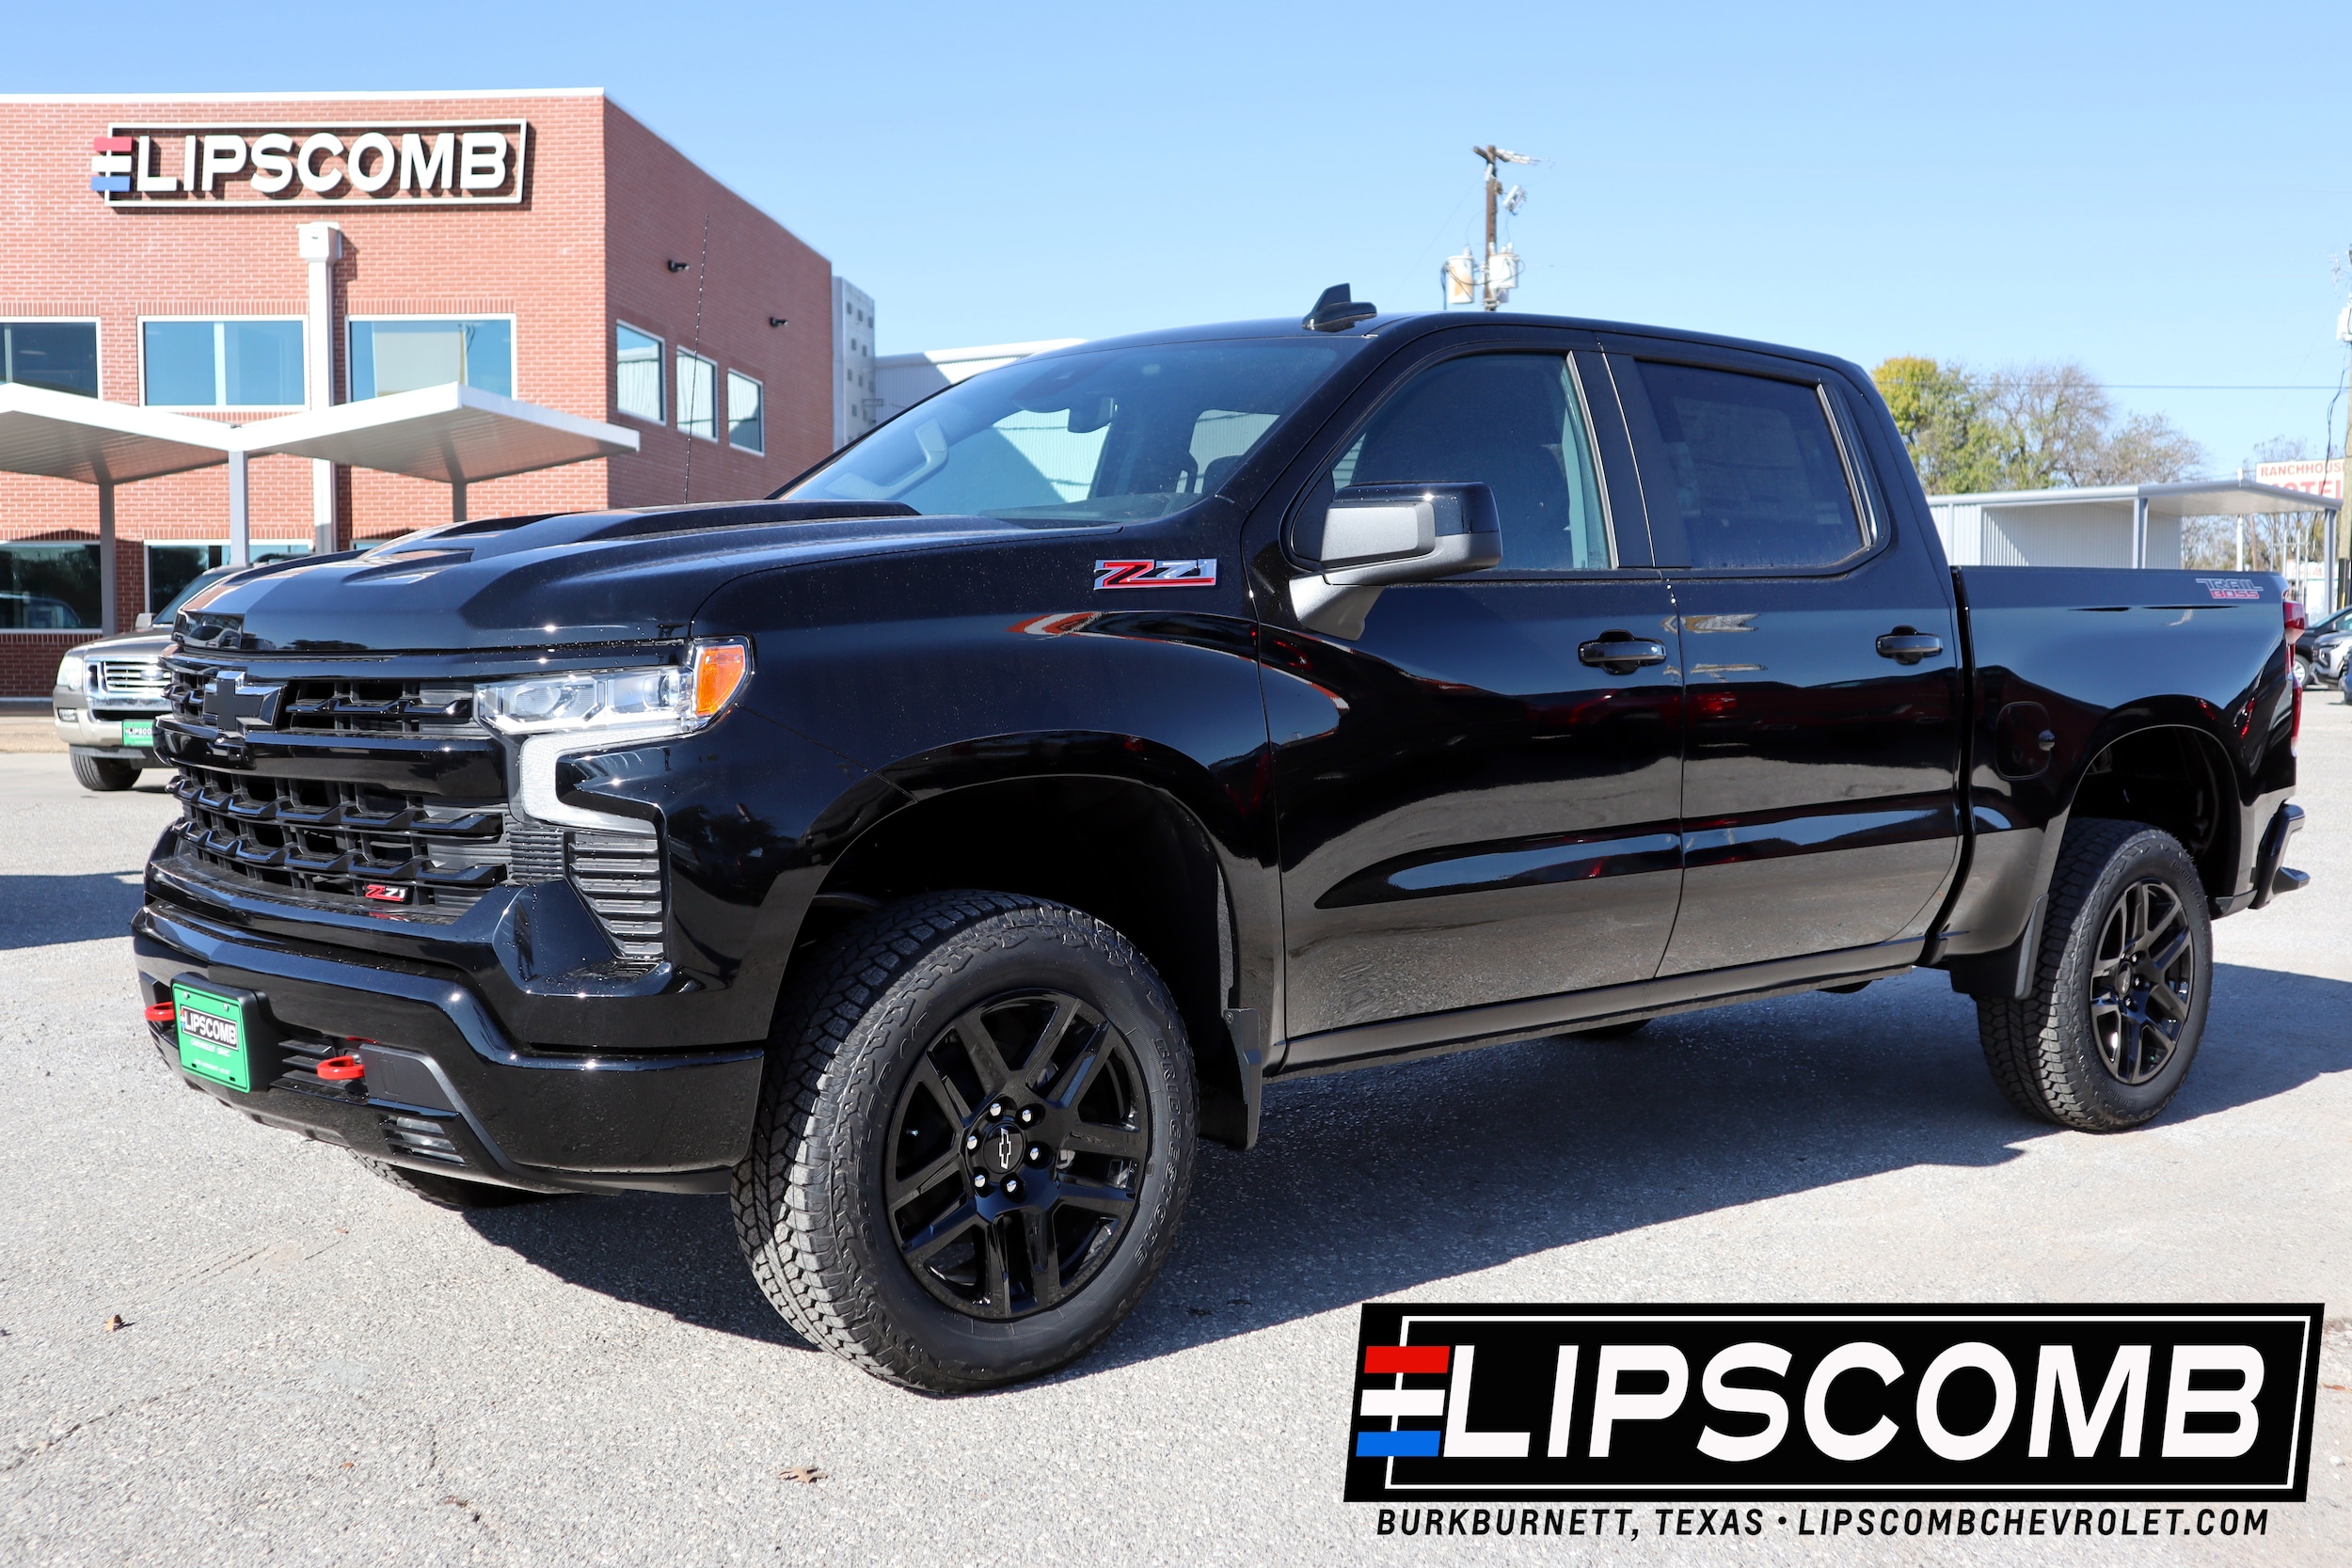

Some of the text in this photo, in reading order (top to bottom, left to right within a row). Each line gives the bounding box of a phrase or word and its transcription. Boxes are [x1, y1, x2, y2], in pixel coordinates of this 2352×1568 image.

[136, 133, 508, 192] LIPSCOMB
[2261, 462, 2345, 477] RANCHHOUS
[1094, 559, 1217, 590] Z71
[2196, 578, 2264, 591] TRAIL
[2211, 589, 2260, 599] BOSS
[365, 884, 407, 902] Z71
[183, 1010, 237, 1045] LIPSCOMB
